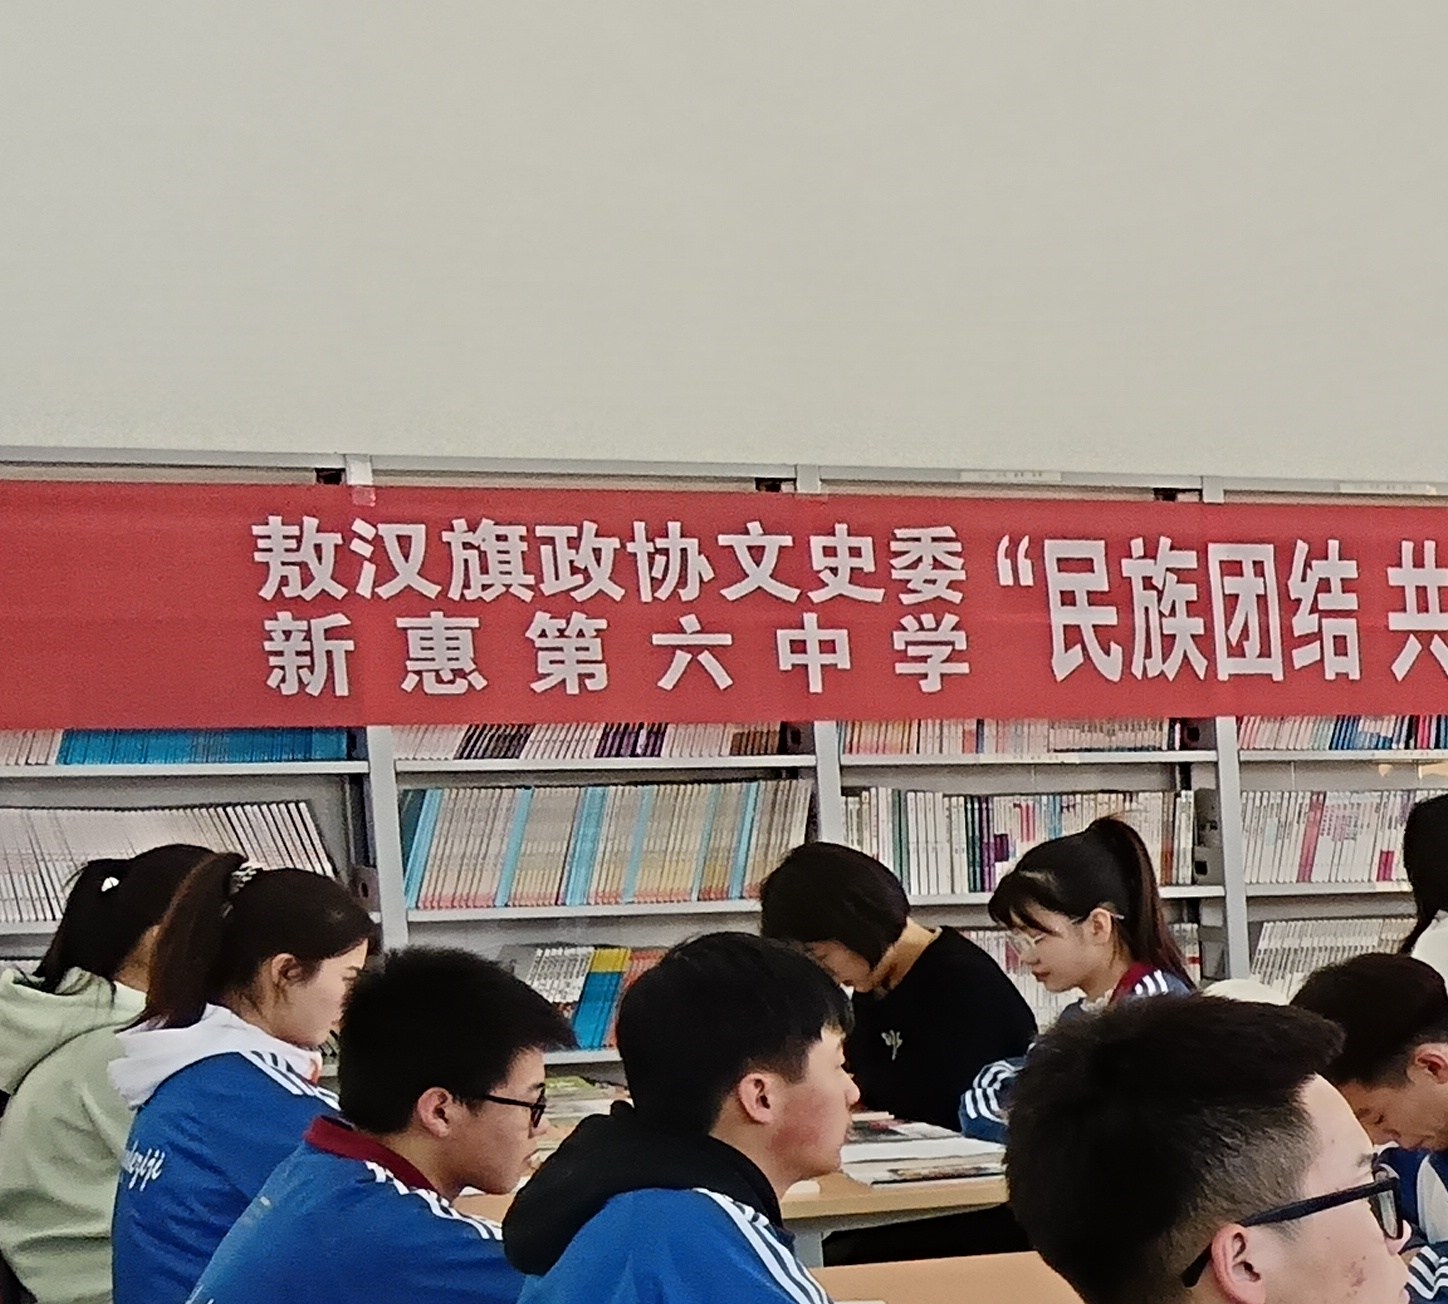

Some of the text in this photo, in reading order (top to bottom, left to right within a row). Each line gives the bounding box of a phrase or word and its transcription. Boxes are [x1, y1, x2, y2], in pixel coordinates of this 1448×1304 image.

[252, 516, 968, 604] 敖汉旗政协文史委
